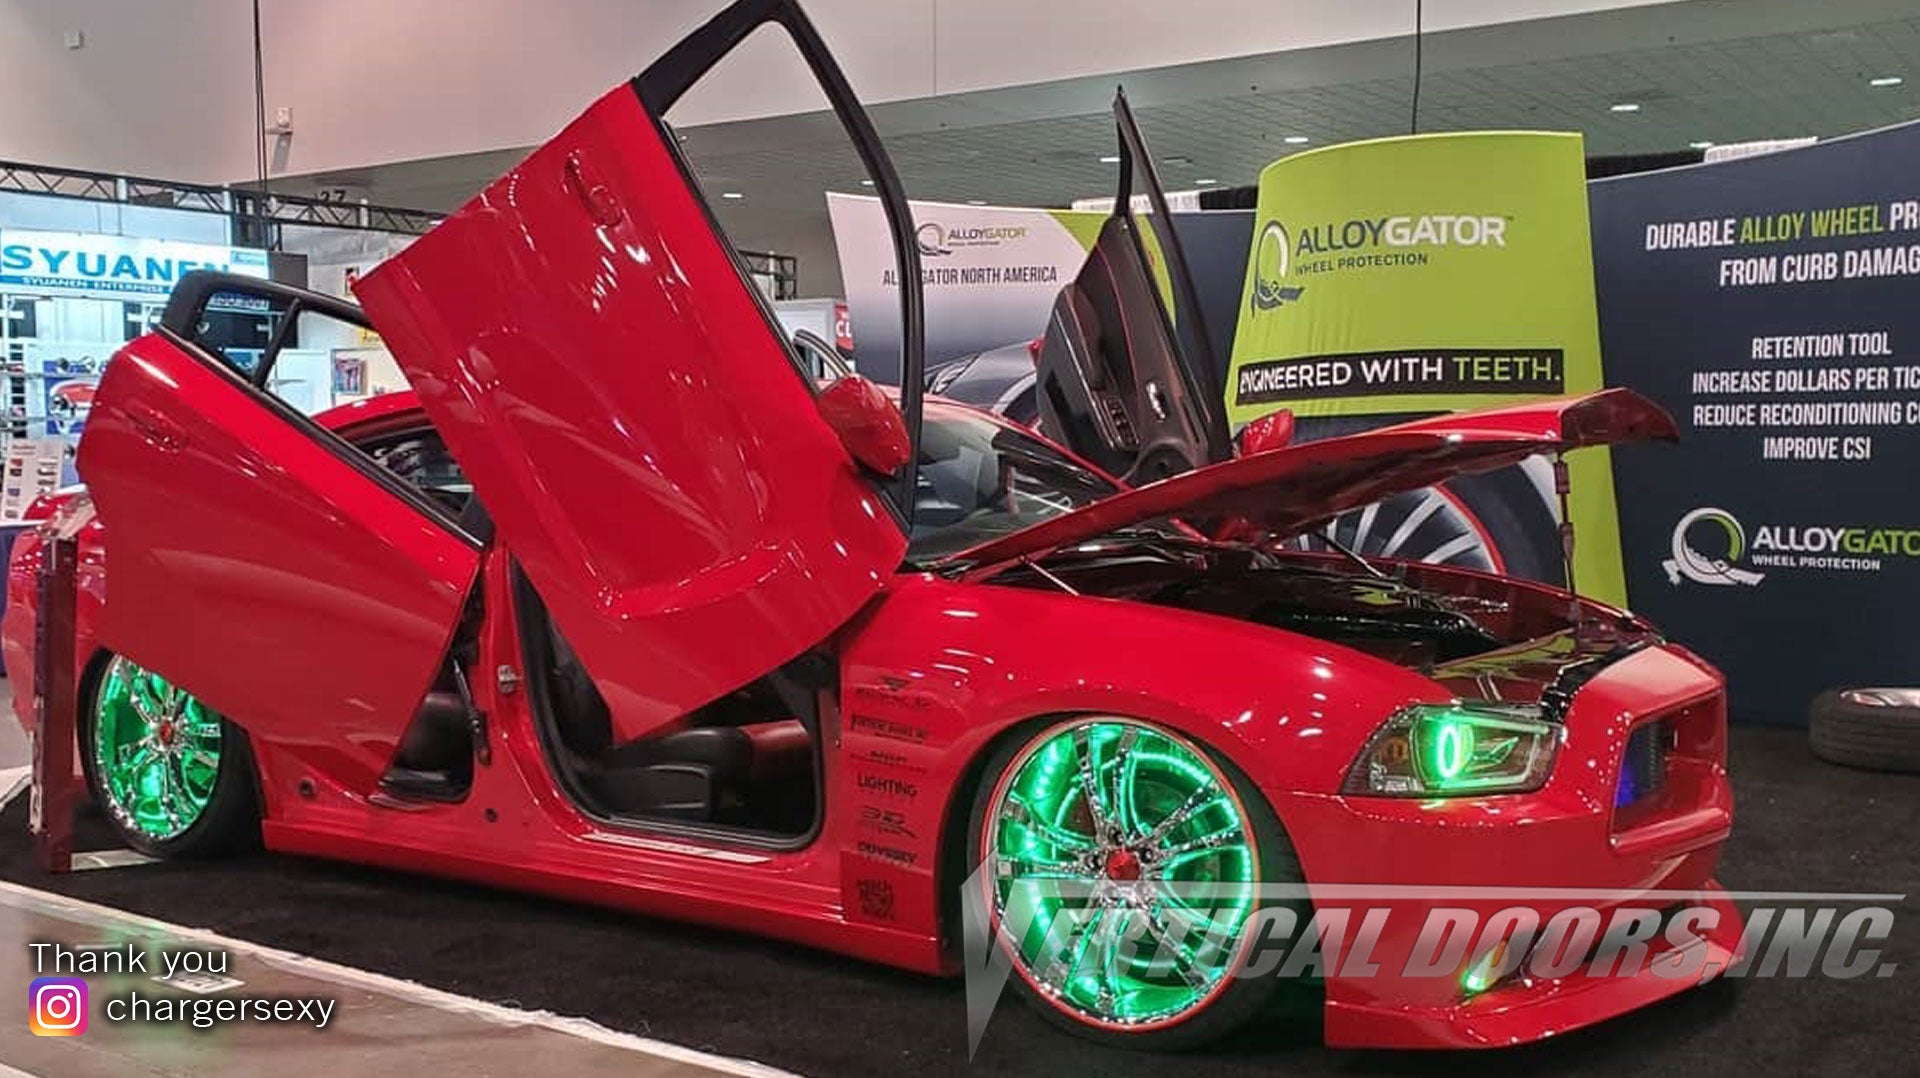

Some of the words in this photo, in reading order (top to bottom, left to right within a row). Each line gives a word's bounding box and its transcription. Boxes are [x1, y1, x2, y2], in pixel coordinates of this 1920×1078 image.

[948, 226, 1027, 240] ALLOYGATOR
[1295, 214, 1507, 257] ALLOYGATOR
[1646, 218, 1736, 250] DURABLE
[1739, 213, 1805, 244] ALLOY
[1811, 204, 1883, 237] WHEEL
[1889, 200, 1920, 232] PR
[883, 268, 959, 286] ALGATOR
[960, 267, 999, 284] NORTH
[1003, 265, 1058, 283] AMERICA
[1294, 260, 1335, 277] WHEEL
[1338, 252, 1428, 271] PROTECTION
[1719, 256, 1777, 287] FROM
[1782, 252, 1838, 282] CURB
[1752, 334, 1844, 360] RETENTION
[1848, 332, 1892, 356] TOOL
[1240, 361, 1352, 394] ENGINEERED
[1360, 357, 1443, 383] WITH
[1452, 356, 1561, 381] TEETH.
[1692, 371, 1771, 394] INCREASE
[1775, 368, 1851, 392] DOLLARS
[1855, 366, 1889, 391] PER
[1893, 365, 1920, 389] TIC
[1693, 404, 1756, 427] REDUCE
[1760, 402, 1901, 426] RECONDITIONING
[1906, 401, 1920, 425] C
[1763, 436, 1839, 460] IMPROVE
[1843, 436, 1872, 460] CSI
[1752, 554, 1798, 568] WHEEL
[1800, 556, 1881, 571] PROTECTION
[857, 773, 918, 797] LIGHTING
